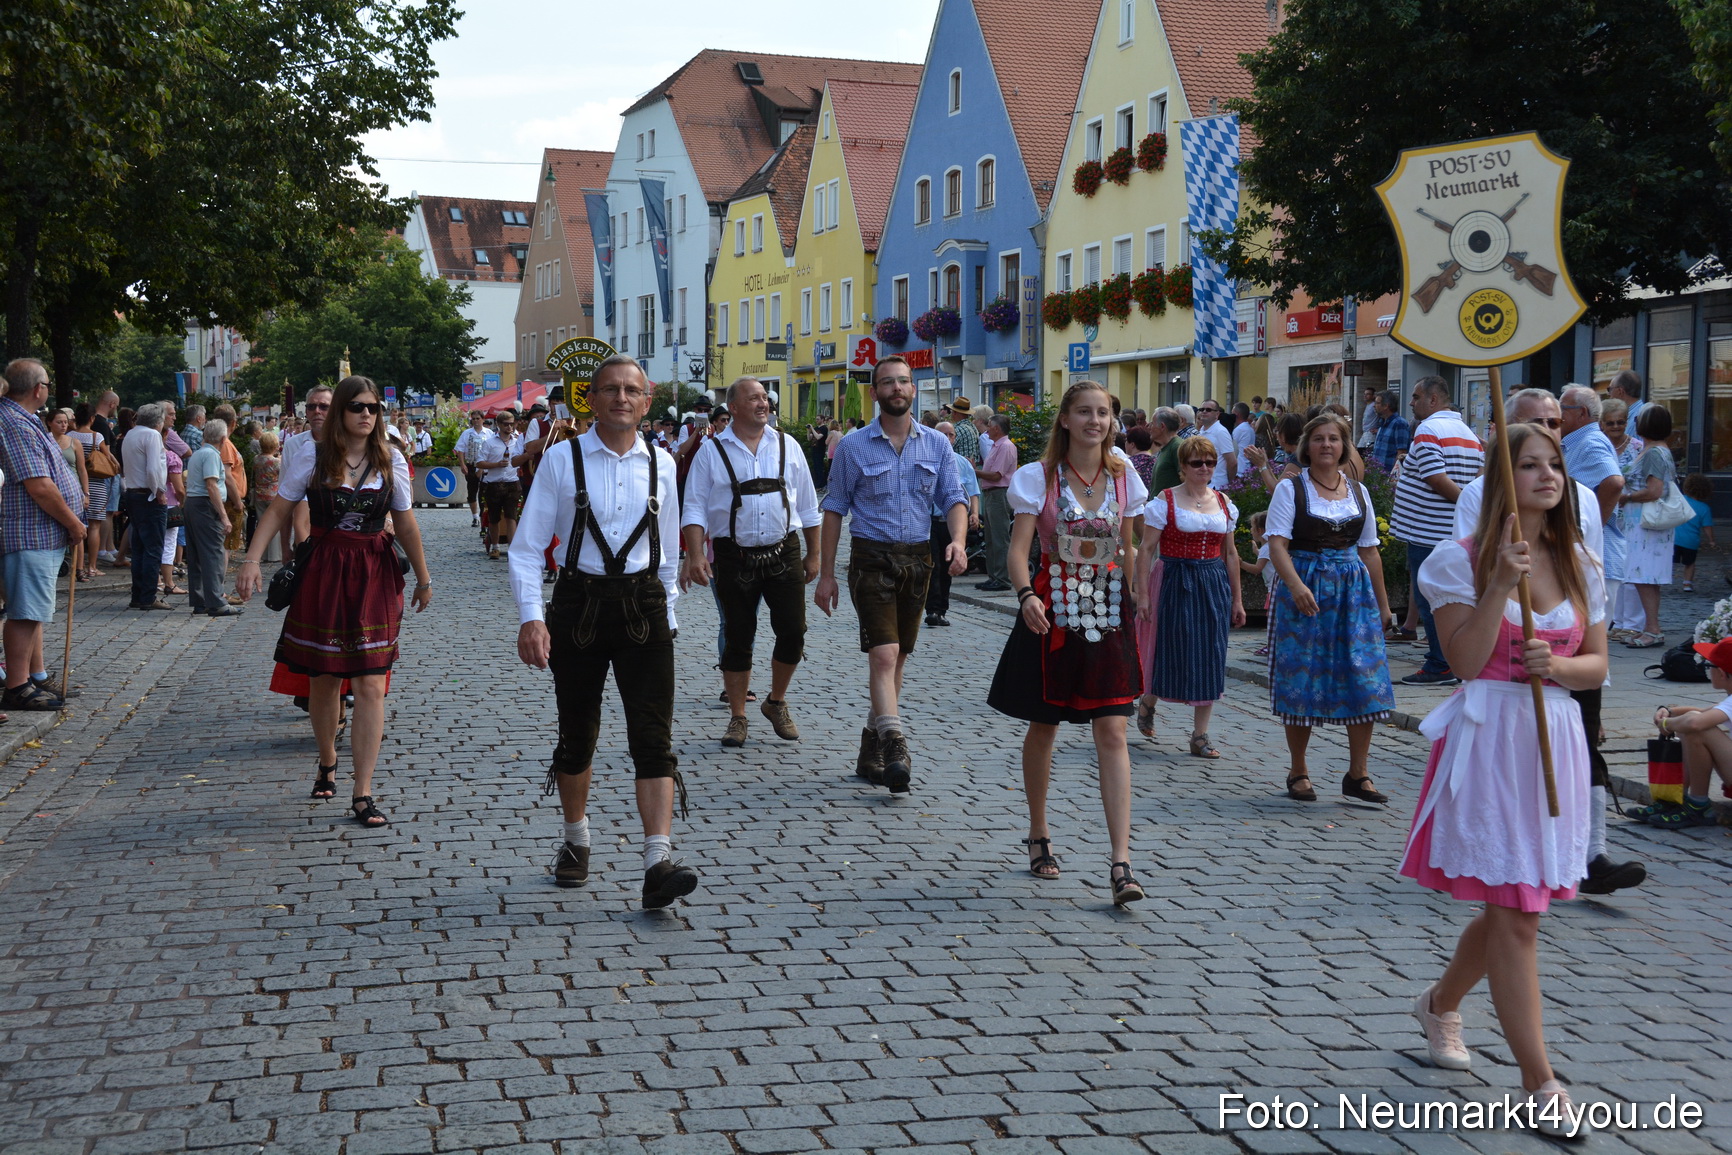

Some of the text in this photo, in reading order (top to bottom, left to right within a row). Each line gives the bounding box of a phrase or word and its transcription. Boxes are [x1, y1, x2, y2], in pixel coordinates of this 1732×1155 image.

[1425, 170, 1520, 200] Neumarkt
[745, 274, 763, 292] HOTEL
[1468, 292, 1507, 308] POST-SV
[1257, 299, 1265, 352] KINO
[1321, 313, 1341, 323] DER
[1287, 321, 1298, 333] DER
[548, 340, 615, 368] Blaskapell
[1073, 346, 1085, 369] P
[562, 356, 601, 373] Pilsac
[742, 361, 769, 375] Restaurant
